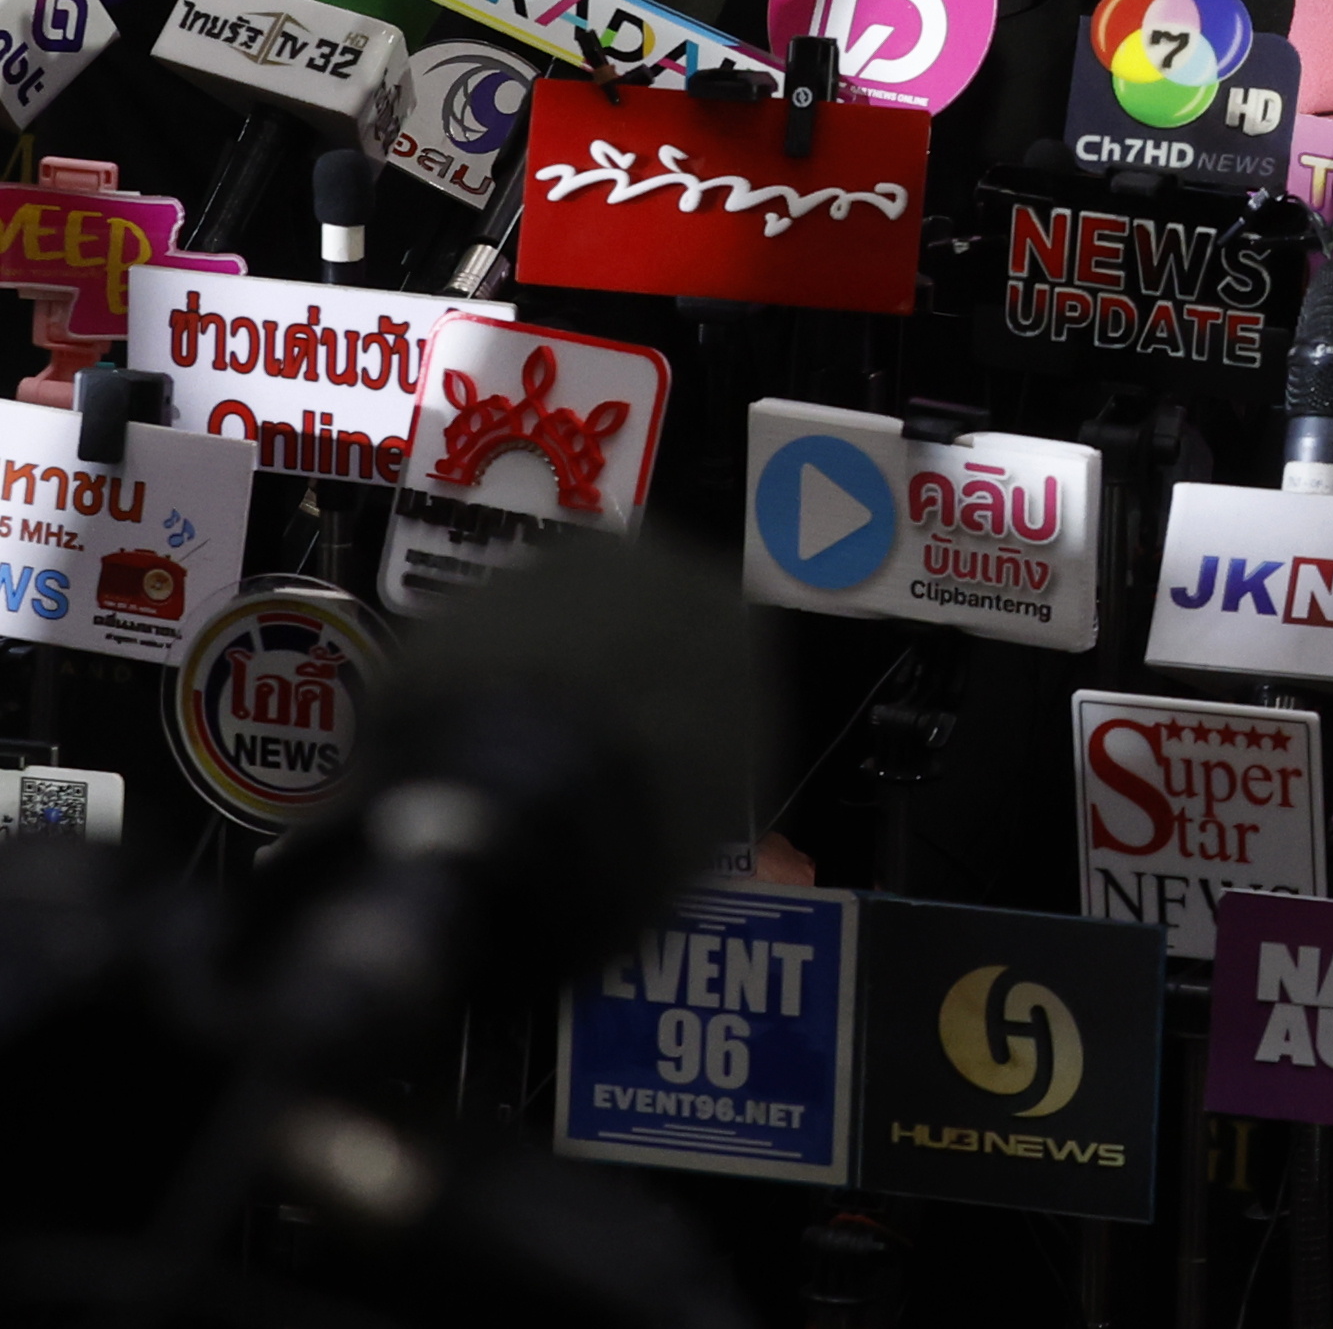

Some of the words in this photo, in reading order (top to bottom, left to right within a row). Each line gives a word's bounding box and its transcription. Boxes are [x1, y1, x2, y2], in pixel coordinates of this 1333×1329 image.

[279, 31, 308, 60] TV
[308, 38, 364, 79] 32
[1151, 30, 1191, 69] 7
[1226, 87, 1283, 137] HD
[1075, 134, 1195, 170] Ch7HD
[1197, 151, 1277, 177] NEWS
[1008, 203, 1272, 309] NEWS
[1005, 280, 1266, 369] UPDATE
[207, 398, 405, 483] Online
[907, 461, 1060, 542] คลิป
[19, 519, 85, 553] MHz.
[921, 532, 1052, 593] บันเทิง
[909, 578, 1053, 623] Clipbanterng
[235, 732, 343, 778] NEWS
[600, 926, 815, 1018] EVENT
[655, 1007, 752, 1090] 96
[592, 1082, 806, 1130] EVENT96.NET
